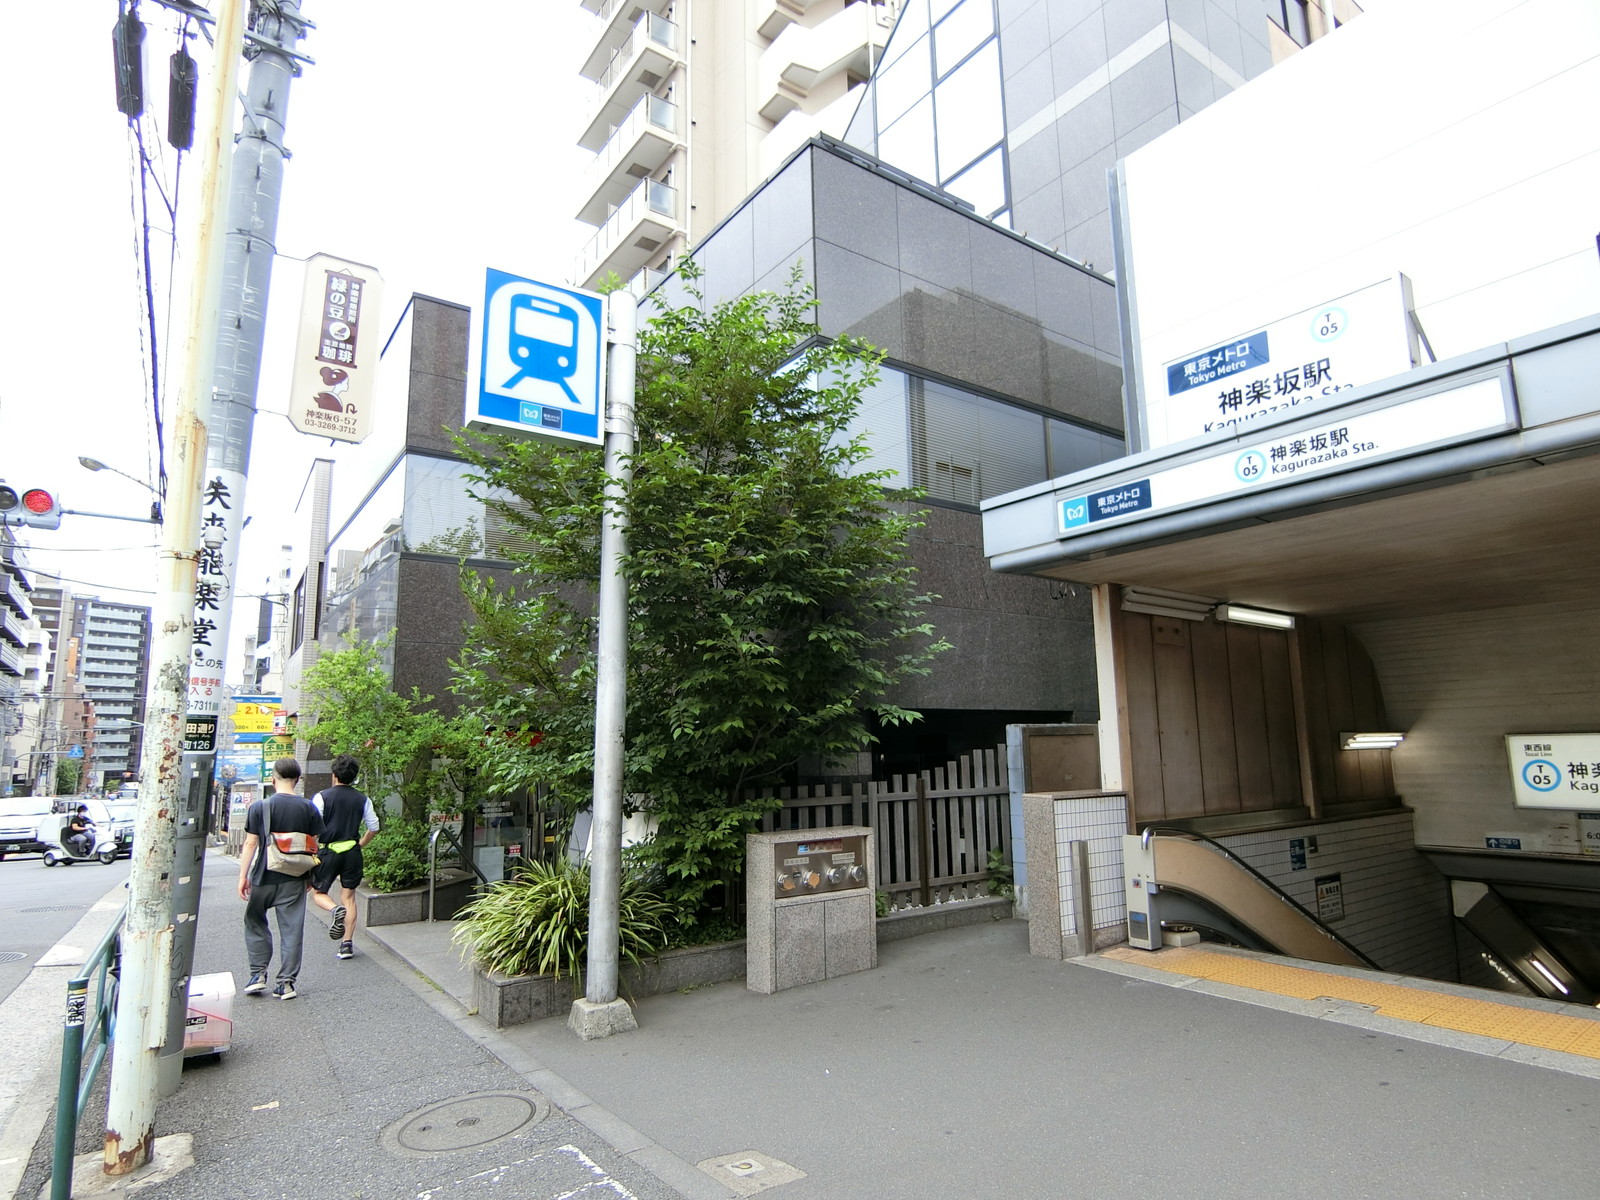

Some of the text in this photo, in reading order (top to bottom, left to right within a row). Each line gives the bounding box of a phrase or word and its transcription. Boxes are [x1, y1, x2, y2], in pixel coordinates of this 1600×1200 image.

[1324, 313, 1331, 323] T
[1320, 322, 1338, 337] 05
[322, 346, 353, 363] 珈琲
[1183, 343, 1249, 377] 東京メトロ
[1188, 360, 1246, 386] Tokyo Metro
[1217, 357, 1332, 415] 神楽坂駅
[306, 409, 357, 426] 神楽坂6-57
[305, 418, 356, 434] 03-3269-3712
[1270, 427, 1349, 463] 神楽坂駅
[1246, 456, 1252, 465] T
[1272, 442, 1379, 476] Kagurazaka Sta.
[1243, 465, 1258, 477] 05
[1097, 488, 1140, 508] 東京メトロ
[1101, 500, 1138, 515] Tokyo Metro
[195, 658, 224, 670] この先
[1523, 744, 1552, 752] 東西線
[1537, 765, 1544, 774] T
[1533, 775, 1551, 785] 05
